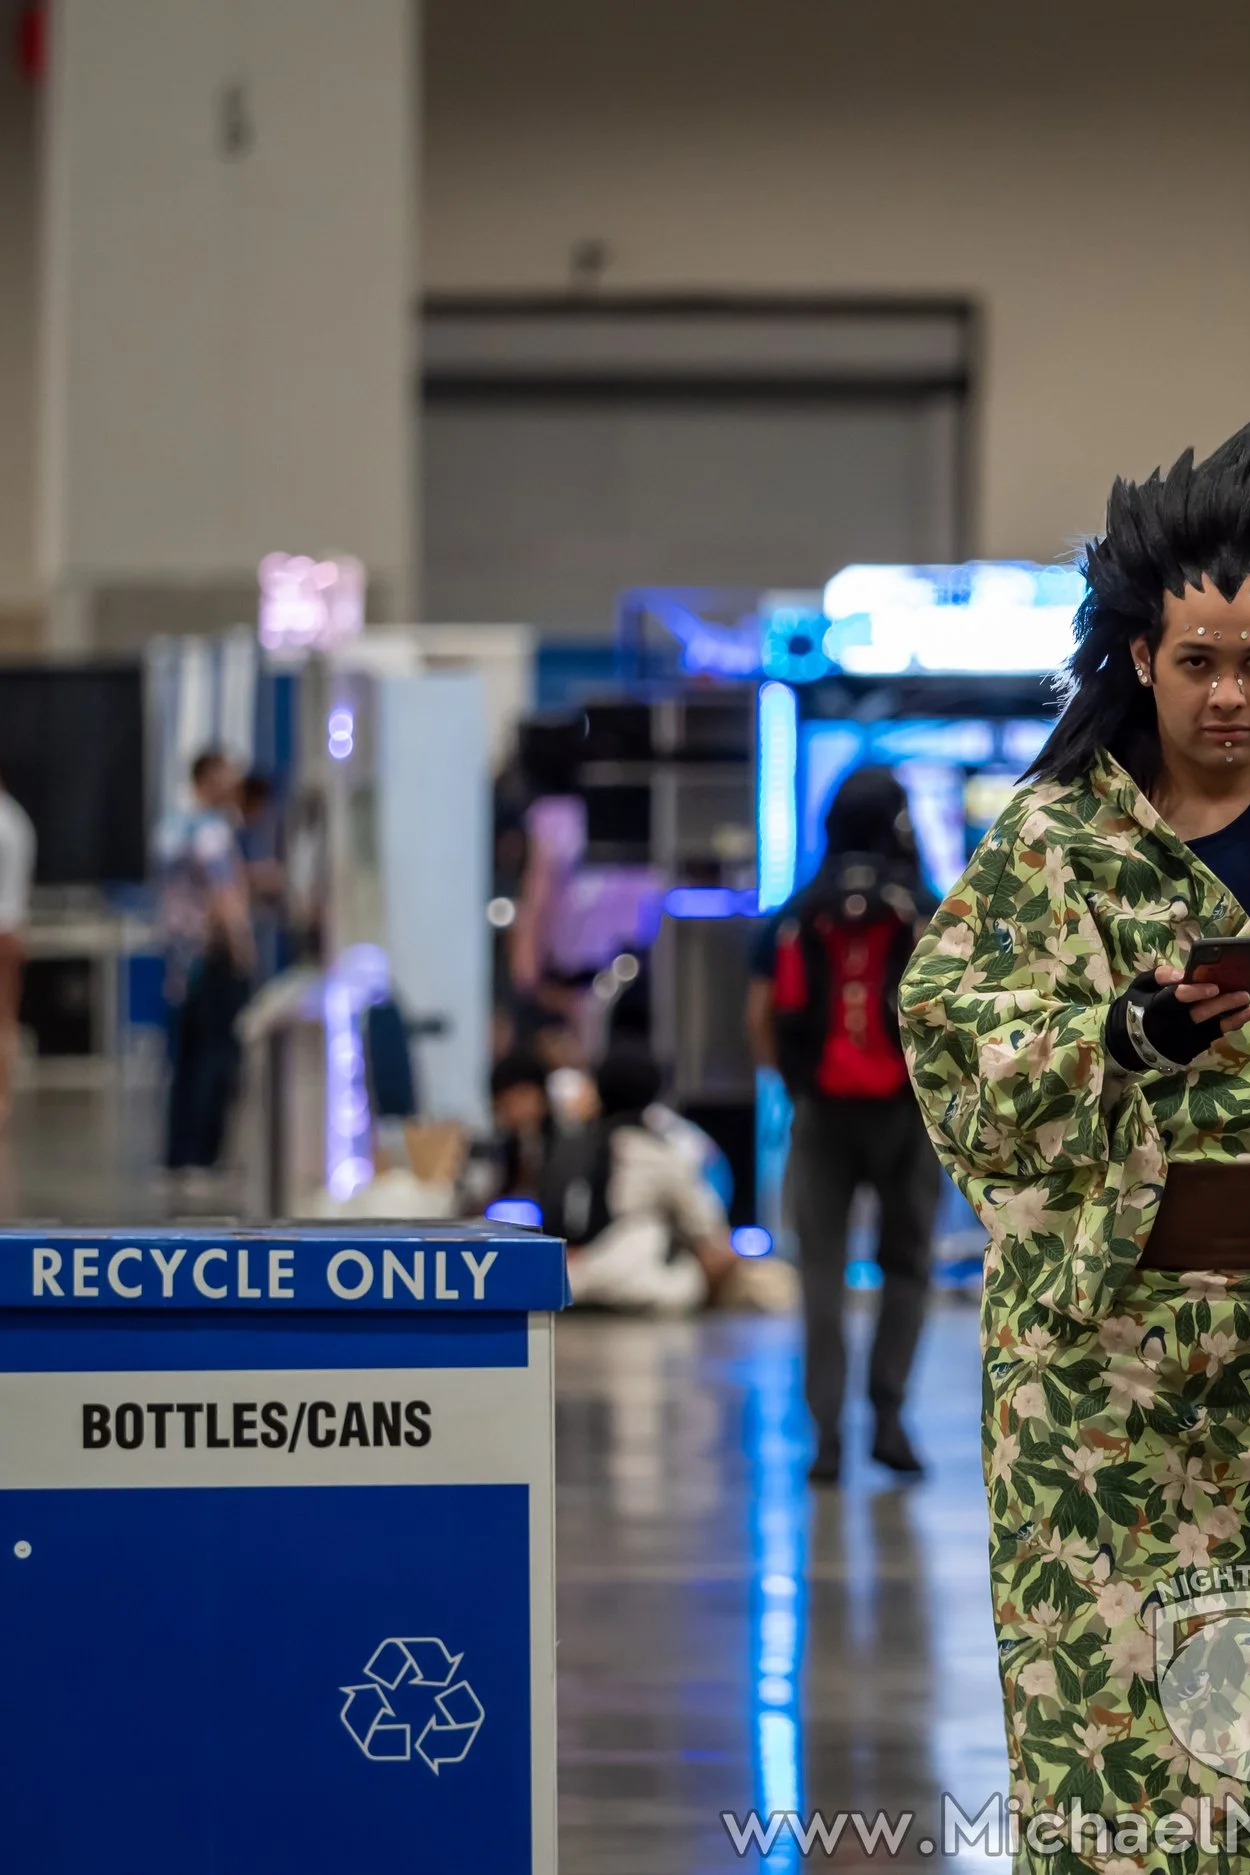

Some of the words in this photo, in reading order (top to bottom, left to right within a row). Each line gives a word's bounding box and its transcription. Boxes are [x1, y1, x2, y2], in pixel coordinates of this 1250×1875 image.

[32, 1248, 295, 1297] RECYCLE
[327, 1250, 498, 1300] ONLY
[82, 1400, 432, 1452] BOTTLES/CANS
